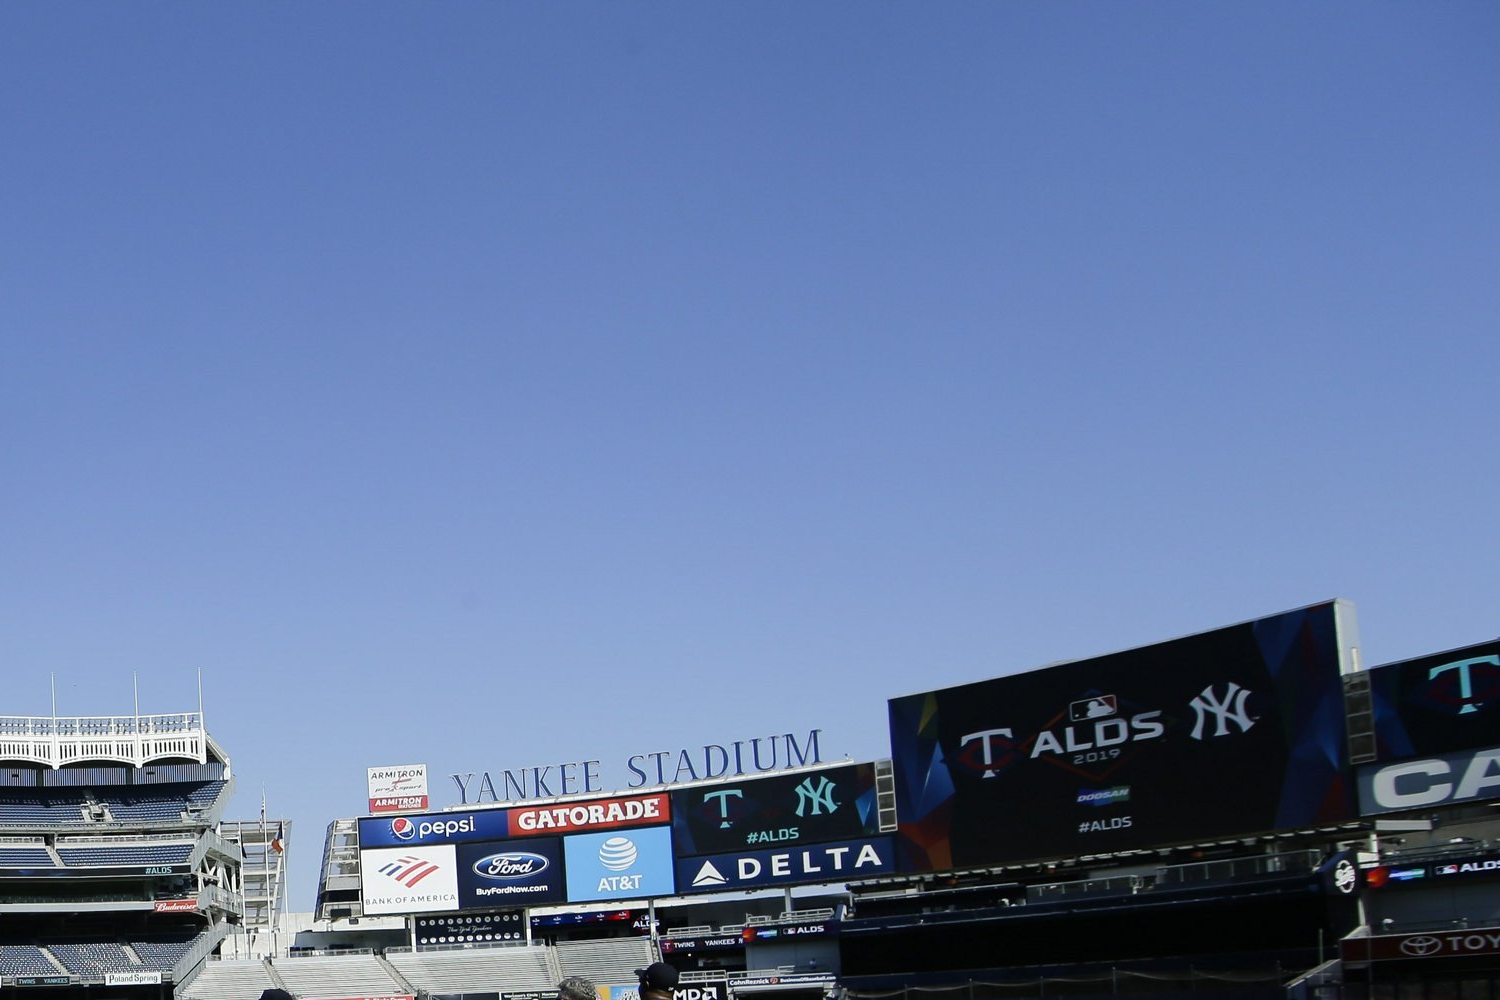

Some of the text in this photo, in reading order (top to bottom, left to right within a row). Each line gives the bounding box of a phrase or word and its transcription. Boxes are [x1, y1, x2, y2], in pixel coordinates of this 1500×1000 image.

[1030, 710, 1165, 760] ALDS
[1073, 749, 1121, 765] 2019
[451, 729, 822, 804] YANKEE STADIUM
[371, 769, 423, 780] ARMITRON
[375, 797, 423, 807] ARMITRON
[1076, 788, 1130, 802] DOOSAN
[517, 797, 661, 831] GATORADE
[419, 816, 474, 839] pepsi
[1078, 816, 1132, 833] #ALDS
[746, 827, 799, 845] #ALDS
[488, 856, 534, 875] Ford
[738, 844, 883, 880] DELTA
[476, 884, 548, 896] BuyFordNow.com
[598, 874, 642, 892] AT&T
[156, 902, 197, 912] Budweiser
[366, 898, 393, 906] BANK
[410, 894, 457, 903] AMERICA
[797, 925, 824, 934] ALDS
[674, 941, 695, 949] TWINS
[109, 973, 158, 984] Poland Spring
[673, 988, 701, 1000] MD
